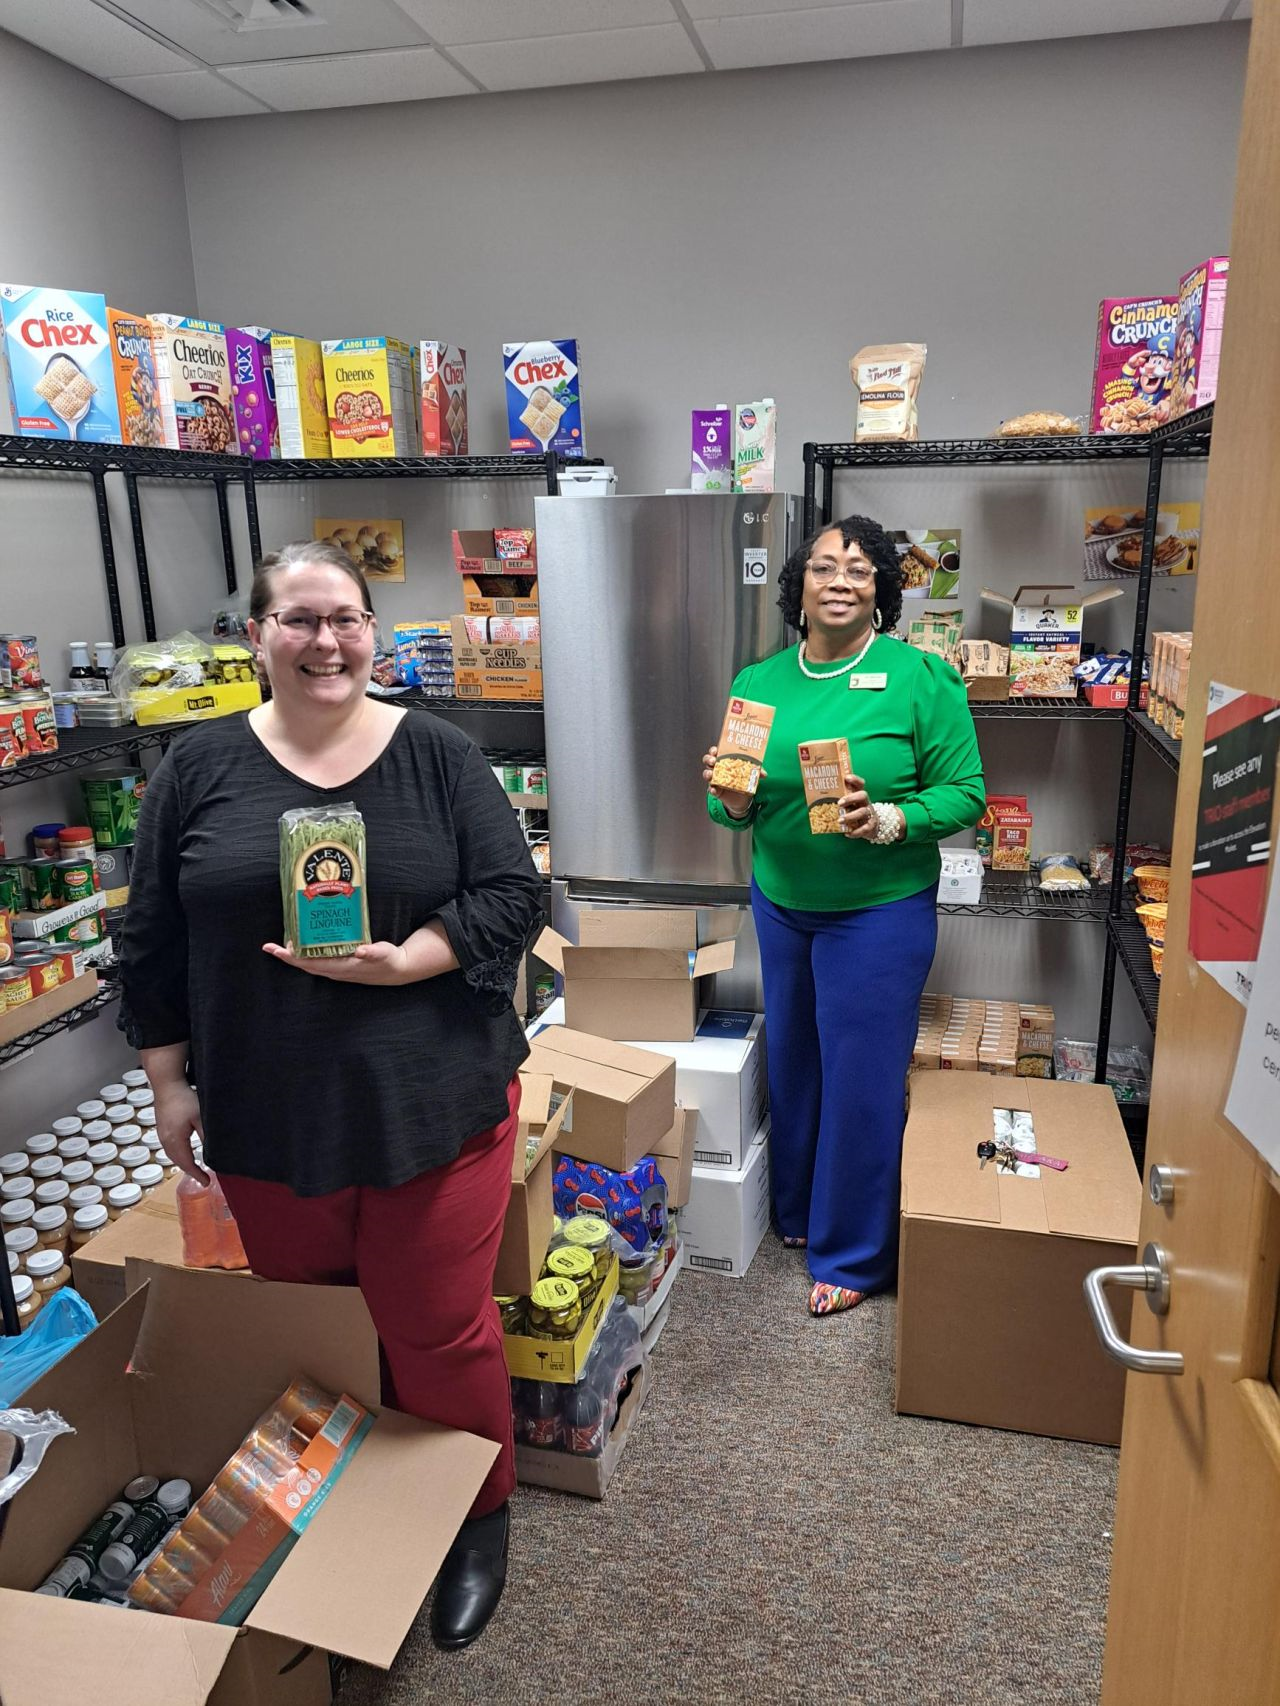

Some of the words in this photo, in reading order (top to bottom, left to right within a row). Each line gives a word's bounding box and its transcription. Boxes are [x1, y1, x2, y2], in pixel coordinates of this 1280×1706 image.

[45, 308, 74, 322] Rice
[1110, 303, 1179, 325] Cinnamo
[186, 319, 207, 331] LARGE
[21, 318, 98, 348] Chex
[342, 341, 363, 349] LARGE
[365, 339, 379, 347] SIZE
[1158, 336, 1170, 350] C
[173, 338, 226, 368] Cheerios
[531, 354, 561, 365] Blueberry
[236, 344, 256, 384] KIX
[426, 349, 435, 374] Chex
[182, 365, 196, 380] OAT
[335, 367, 375, 383] Cheerios
[443, 362, 465, 385] Chex
[513, 359, 568, 386] Chex
[1104, 378, 1133, 390] AMAZING
[1103, 386, 1134, 399] CINNAMON
[737, 447, 764, 464] MILK
[745, 562, 766, 578] 10
[1067, 610, 1078, 620] 52
[494, 649, 518, 658] CUP
[485, 657, 526, 669] NOODLES
[727, 719, 769, 739] MACARONI
[727, 731, 734, 743] &
[735, 733, 764, 750] CHEESE
[804, 764, 839, 779] MACARONI
[1212, 769, 1234, 790] Please
[1234, 762, 1247, 779] see
[1247, 754, 1263, 774] any
[807, 778, 813, 791] &
[813, 777, 839, 790] CHEESE
[305, 849, 352, 881] VALENTE
[41, 915, 74, 934] Growers
[79, 898, 101, 917] Good
[310, 907, 350, 920] SPINACH
[309, 917, 352, 930] LINGUINE
[1021, 1031, 1053, 1041] MACARONI
[1028, 1041, 1050, 1049] CHEESE
